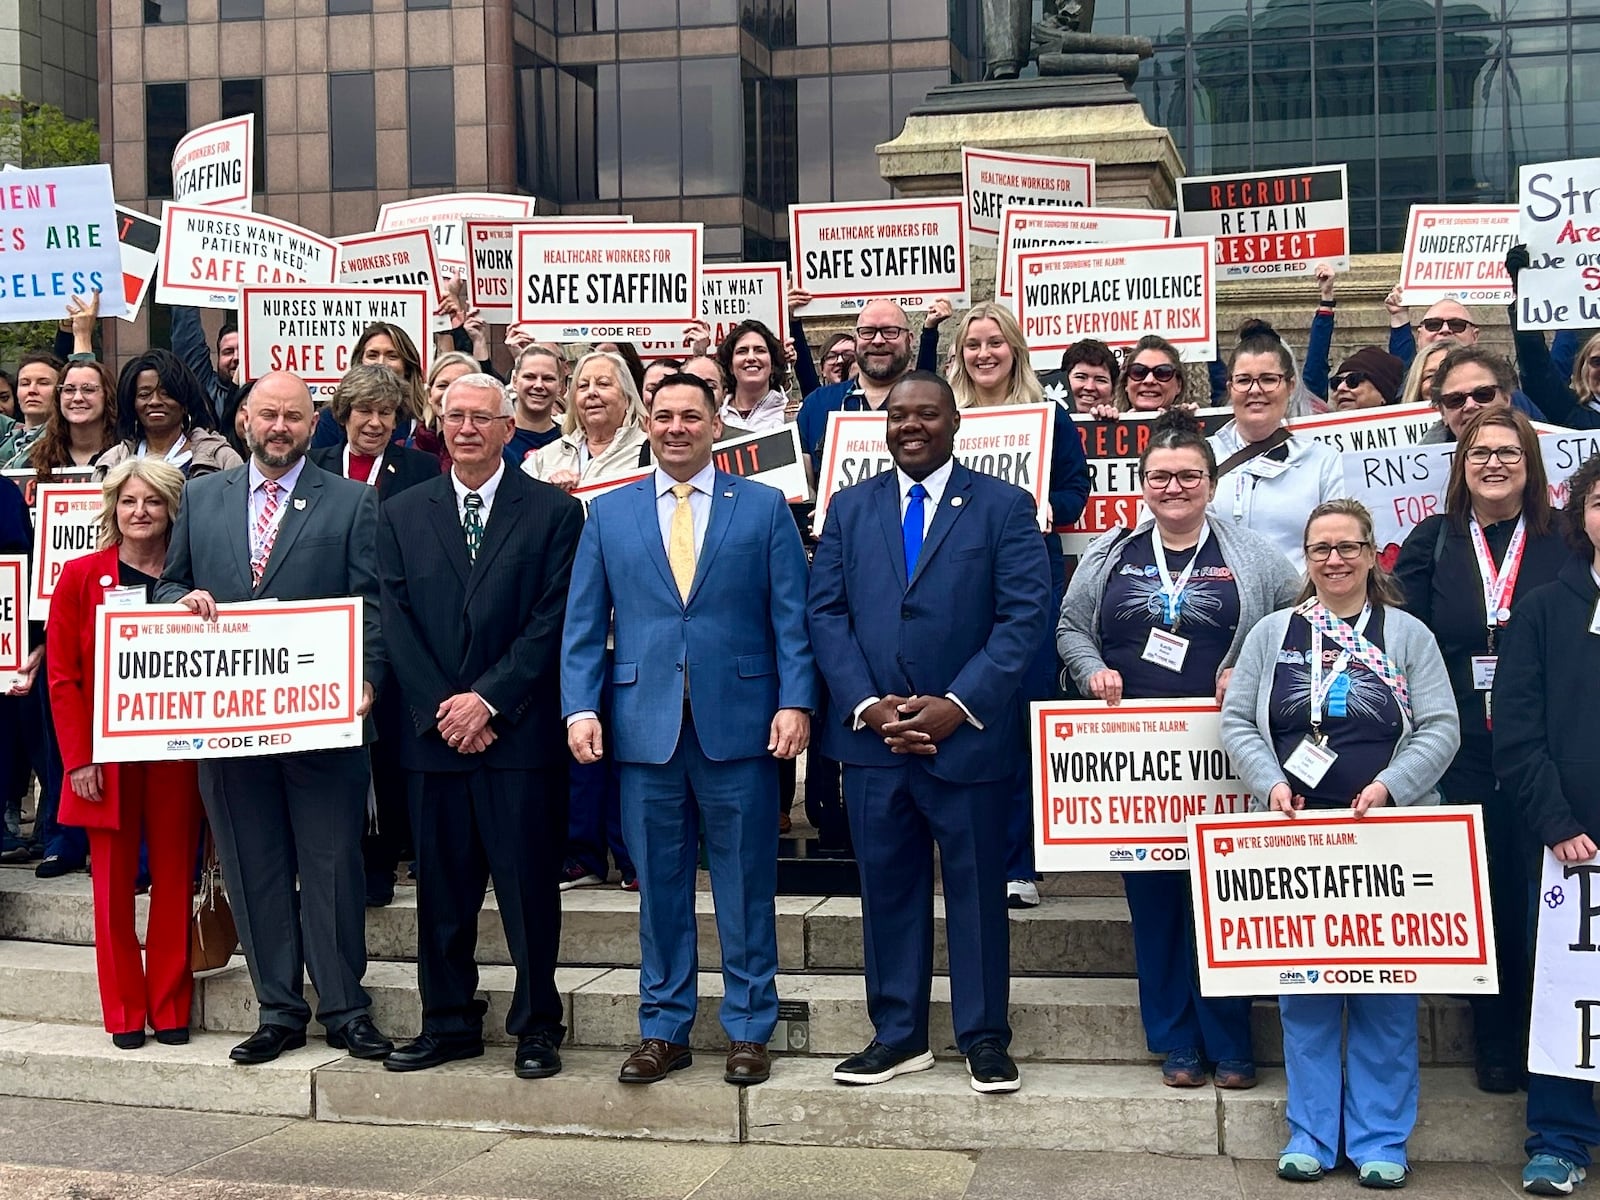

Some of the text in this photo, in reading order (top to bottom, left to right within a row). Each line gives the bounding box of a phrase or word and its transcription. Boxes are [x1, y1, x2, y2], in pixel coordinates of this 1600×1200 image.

[216, 141, 231, 154] FOR
[980, 171, 1071, 192] HEALTHCARE WORKERS FOR
[1210, 177, 1312, 209] RECRUIT
[819, 222, 939, 241] HEALTHCARE WORKERS FOR
[1221, 206, 1306, 235] RETAIN
[46, 223, 101, 249] ARE
[187, 218, 320, 262] NURSES WANT WHAT
[201, 236, 268, 258] PATIENTS
[544, 249, 671, 264] HEALTHCARE WORKERS FOR
[1215, 233, 1317, 263] RESPECT
[190, 256, 246, 283] SAFE
[347, 254, 391, 273] WORKERS
[393, 250, 410, 266] FOR
[806, 244, 956, 280] SAFE STAFFING
[1044, 262, 1062, 271] WE'RE
[1062, 260, 1091, 270] SOUNDING
[1093, 259, 1103, 268] THE
[1252, 264, 1282, 274] CODE
[1284, 262, 1307, 272] RED
[1414, 261, 1474, 281] PATIENT
[476, 277, 508, 296] PUTS
[527, 273, 688, 305] SAFE STAFFING
[728, 279, 764, 295] WHAT
[1025, 274, 1202, 307] WORKPLACE VIOLENCE
[1470, 291, 1501, 300] CODE
[263, 300, 408, 317] NURSES WANT WHAT
[714, 299, 751, 316] NEED:
[900, 297, 923, 307] RED
[1523, 297, 1569, 324] We
[279, 320, 346, 337] PATIENTS
[591, 327, 624, 337] CODE
[626, 327, 651, 337] RED
[1026, 307, 1201, 337] PUTS EVERYONE AT RISK
[271, 344, 325, 372] SAFE
[959, 435, 1000, 451] DESERVE
[1003, 434, 1015, 447] TO
[1016, 433, 1031, 446] BE
[1350, 427, 1397, 451] WANT
[1363, 452, 1430, 489] RN'S
[1393, 494, 1438, 527] FOR
[141, 624, 164, 635] WE'RE
[165, 623, 205, 634] SOUNDING
[207, 622, 221, 634] THE
[118, 647, 289, 680] UNDERSTAFFING
[117, 682, 341, 722] PATIENT CARE CRISIS
[1076, 721, 1189, 734] WE'RE SOUNDING THE ALARM:
[207, 736, 254, 749] CODE
[258, 732, 292, 746] RED
[1050, 749, 1241, 783] WORKPLACE VIOL
[1053, 795, 1238, 825] PUTS EVERYONE AT
[1236, 833, 1358, 849] WE'RE SOUNDING THE ALARM:
[1151, 848, 1189, 861] COD
[1215, 863, 1406, 902] UNDERSTAFFING
[1220, 912, 1470, 950] PATIENT CARE CRISIS
[1323, 970, 1375, 984] CODE
[1379, 970, 1417, 983] RED
